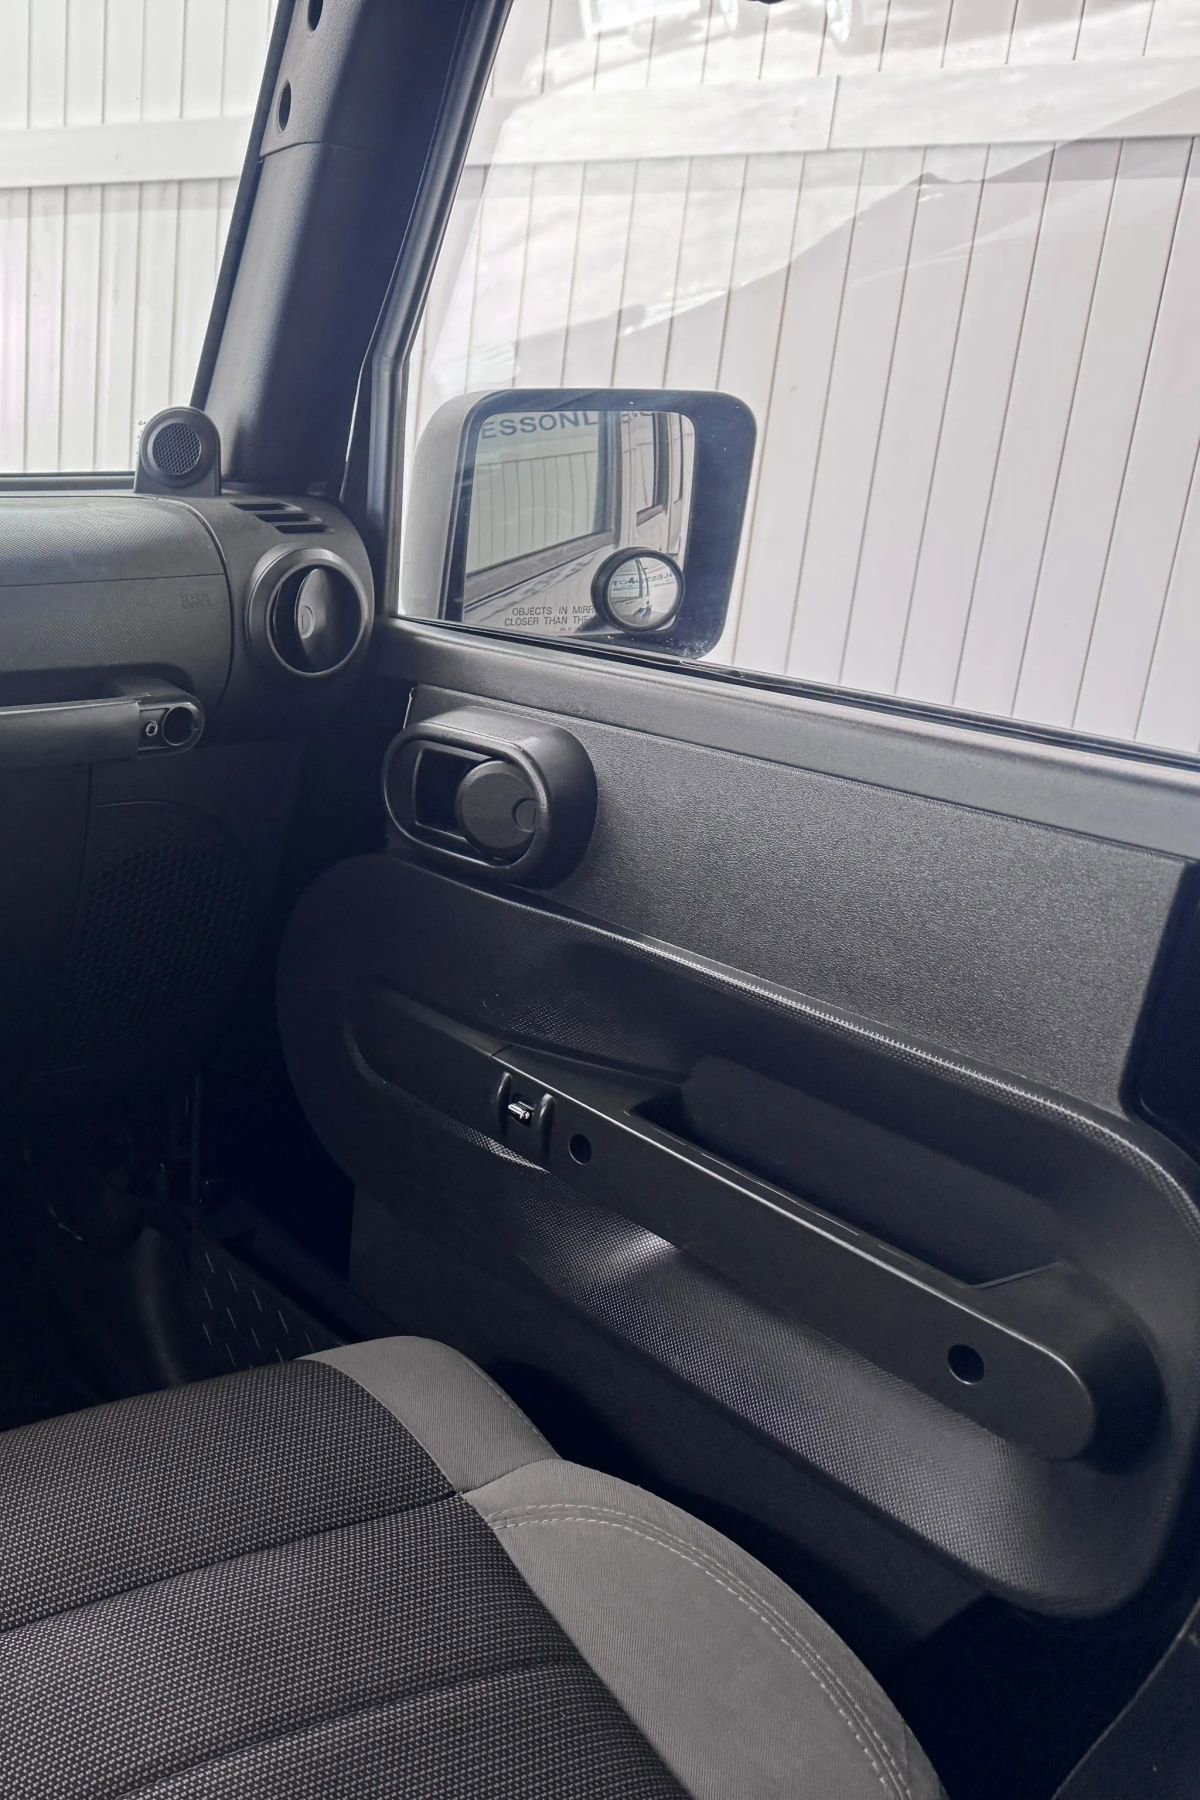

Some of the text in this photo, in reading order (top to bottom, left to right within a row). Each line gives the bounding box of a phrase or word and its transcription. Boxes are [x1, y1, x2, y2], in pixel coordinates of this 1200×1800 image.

[512, 607, 552, 616] OBJECTS
[559, 606, 568, 614] IN
[505, 617, 539, 626] CLOSER
[544, 616, 568, 624] THAN
